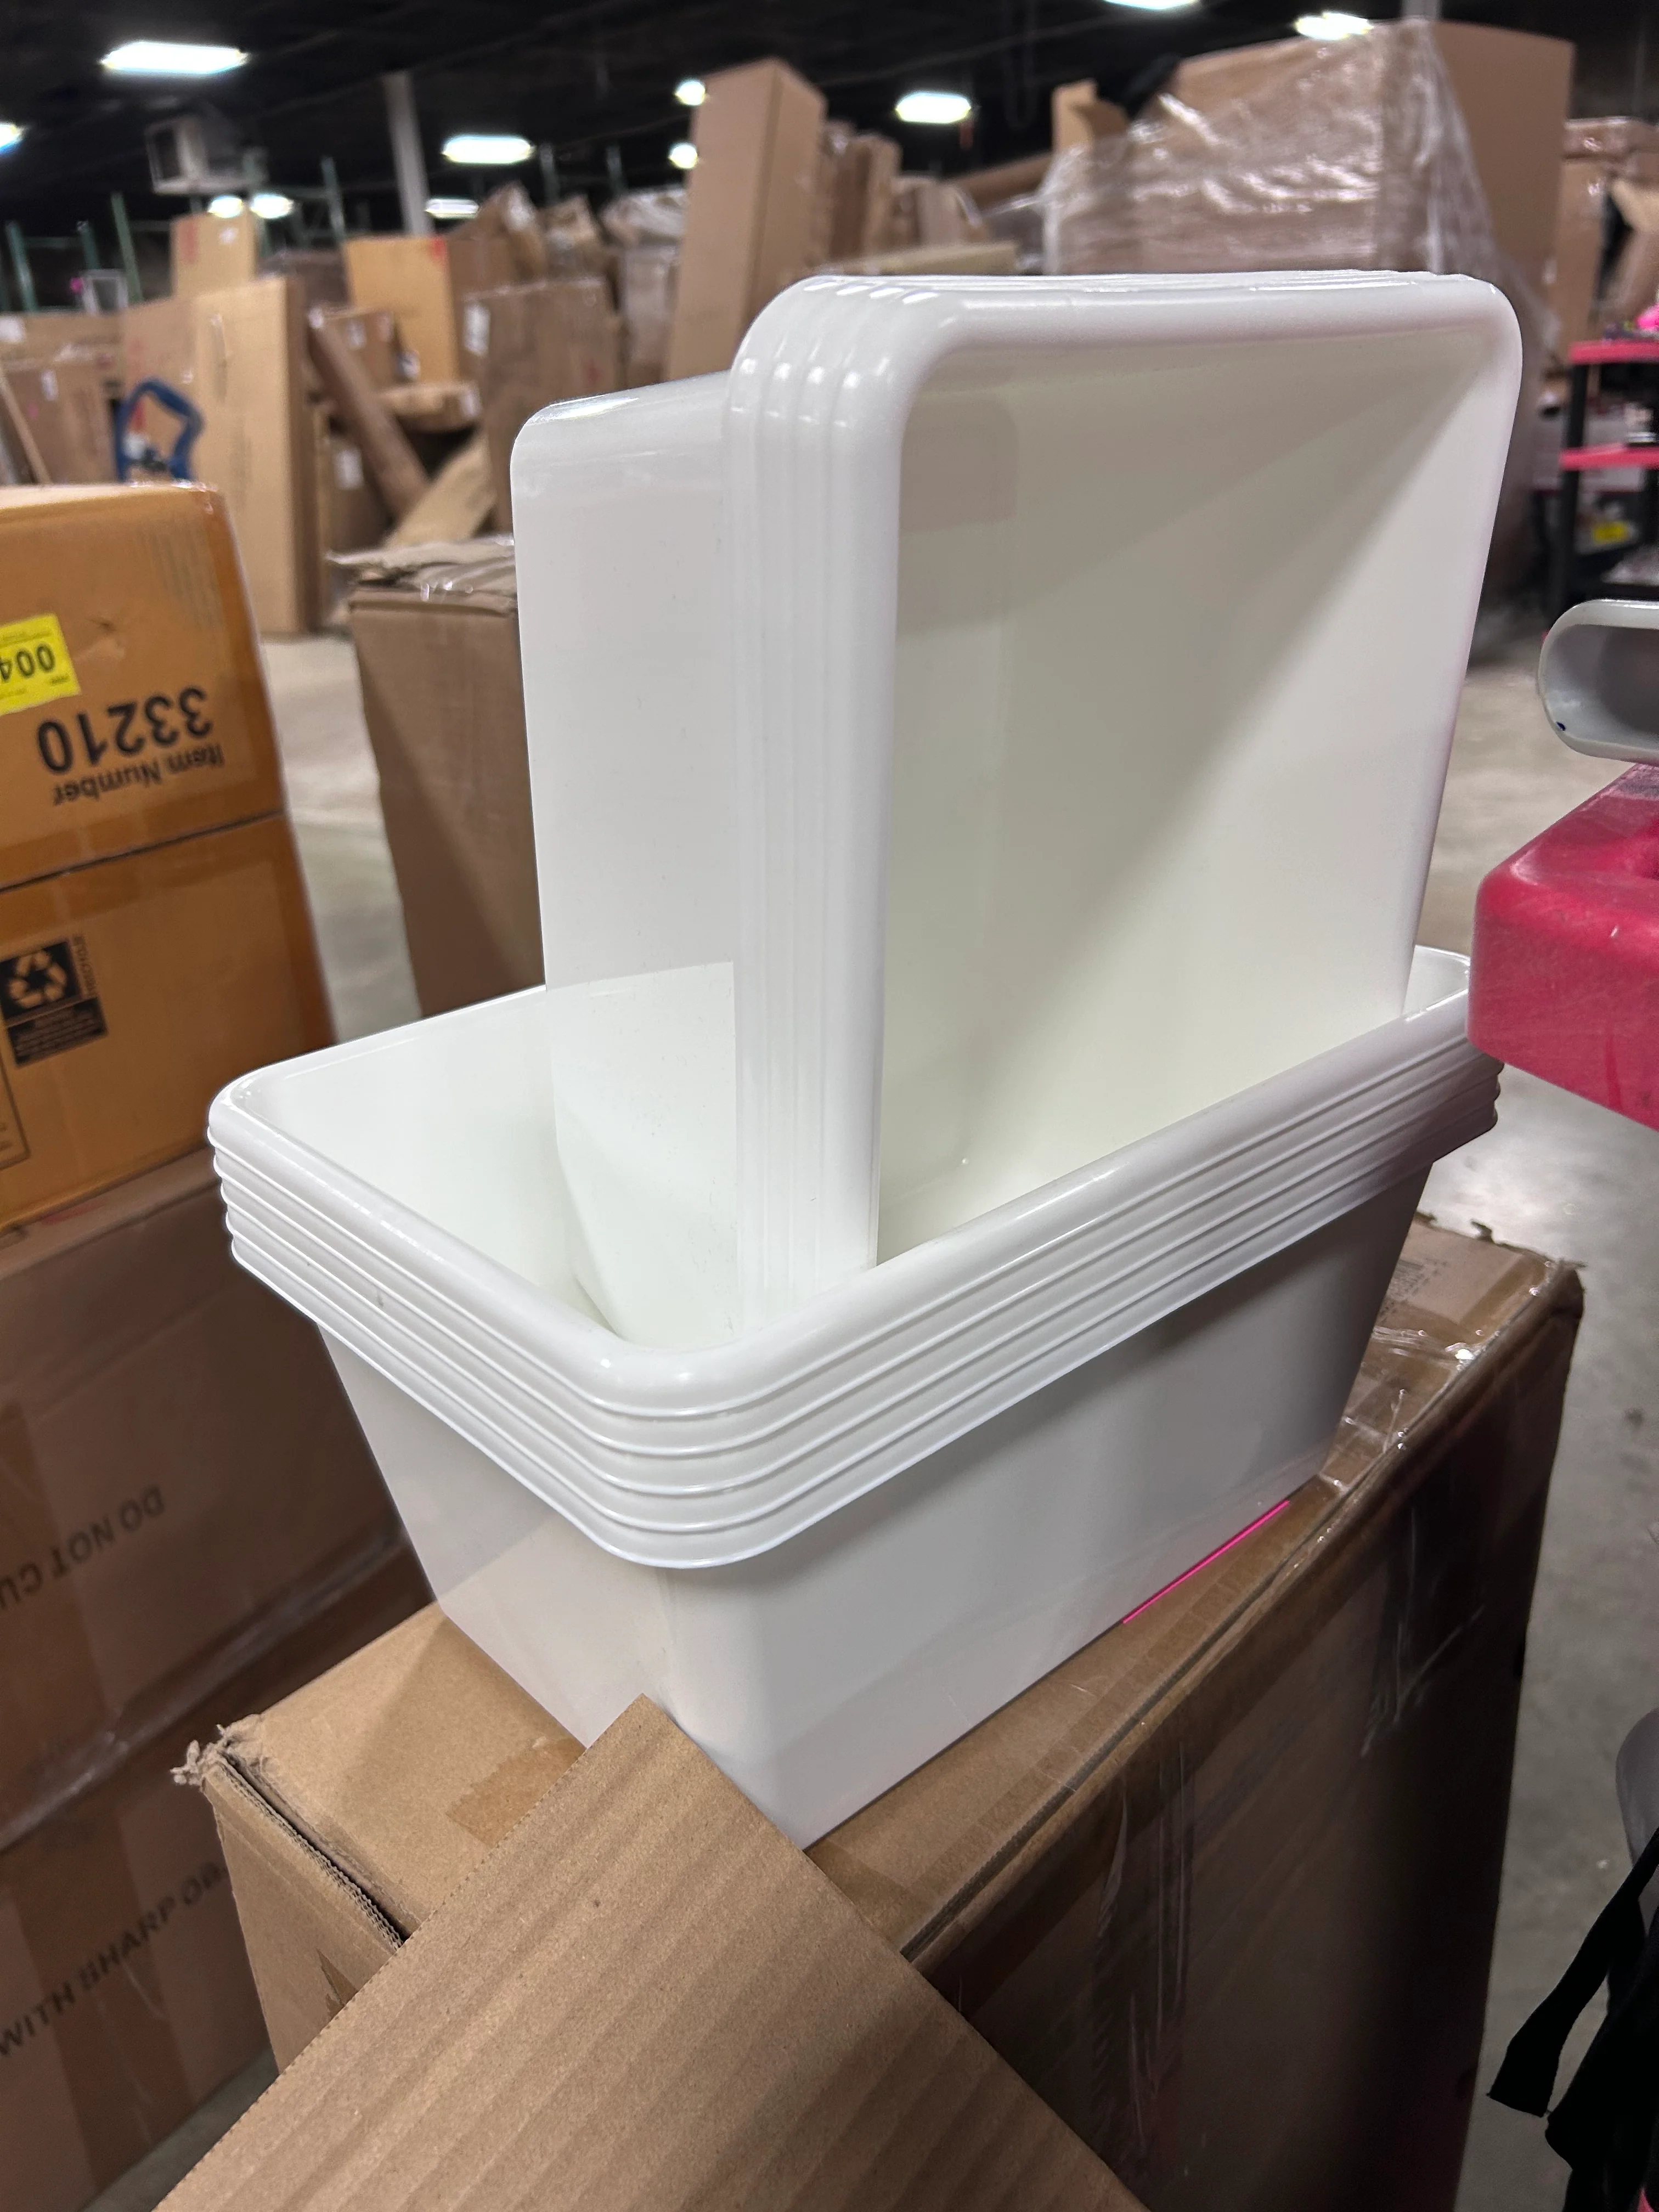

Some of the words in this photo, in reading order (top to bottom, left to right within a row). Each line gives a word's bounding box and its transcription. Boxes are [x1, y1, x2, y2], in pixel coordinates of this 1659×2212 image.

[37, 687, 213, 774] 33210
[168, 744, 224, 772] Item
[53, 759, 161, 805] Number
[120, 1486, 165, 1533] DO
[50, 1517, 116, 1578] NOT
